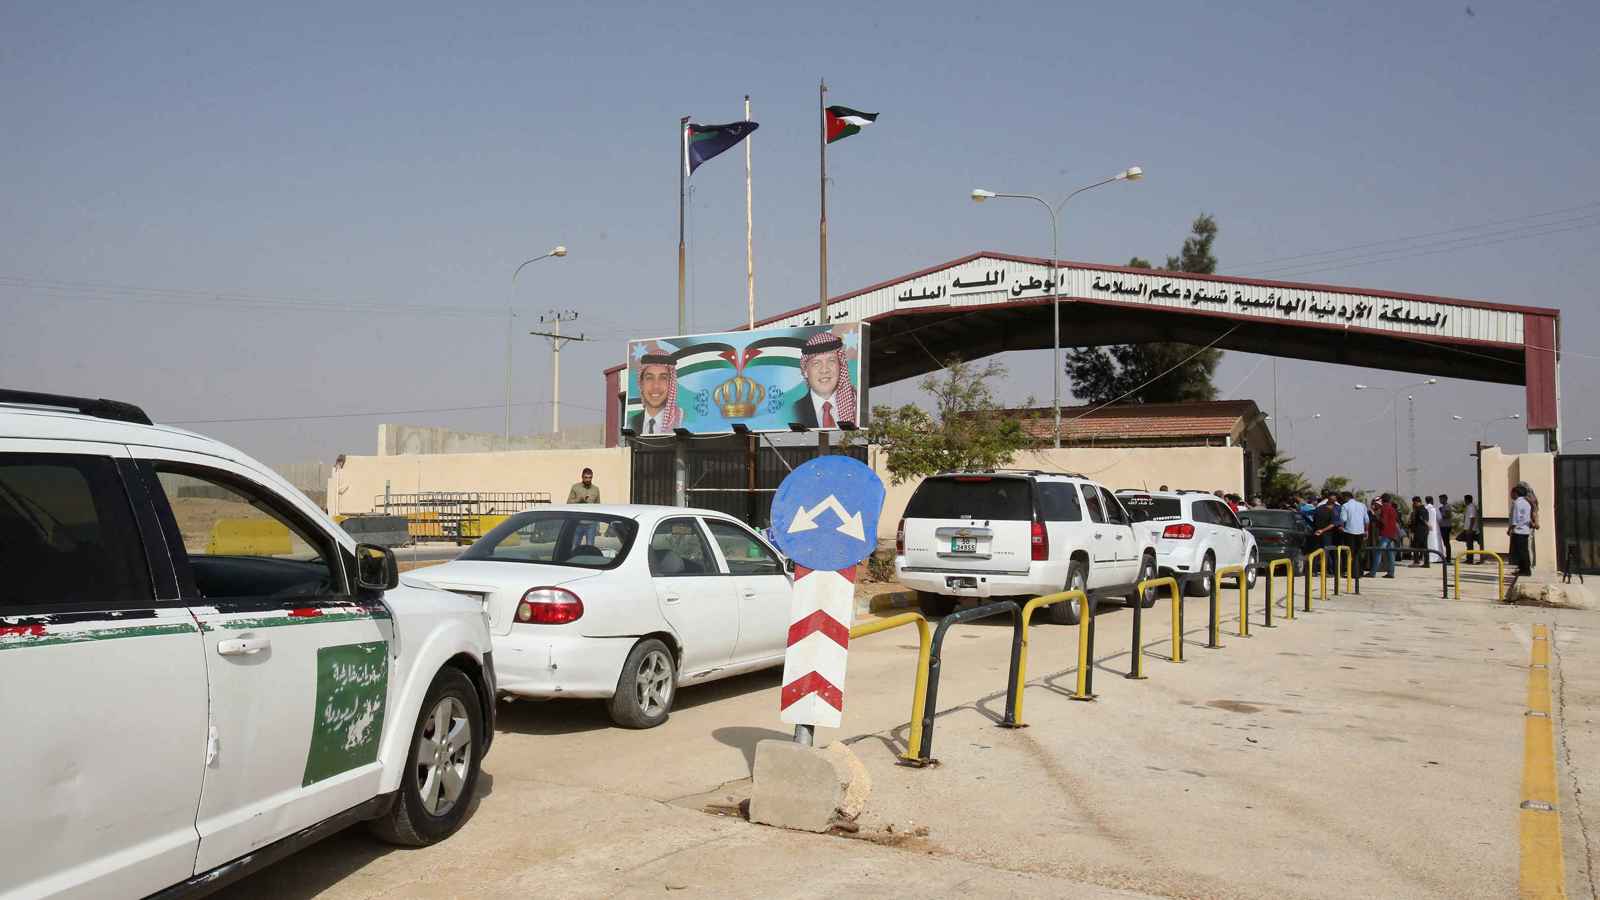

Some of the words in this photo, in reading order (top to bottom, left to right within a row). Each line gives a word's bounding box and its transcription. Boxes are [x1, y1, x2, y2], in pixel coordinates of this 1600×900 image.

[952, 269, 1005, 289] الله
[1092, 276, 1148, 298] السلامة
[898, 285, 947, 302] الملك
[1233, 290, 1307, 315] الهاشمية
[1378, 304, 1449, 328] المملكة
